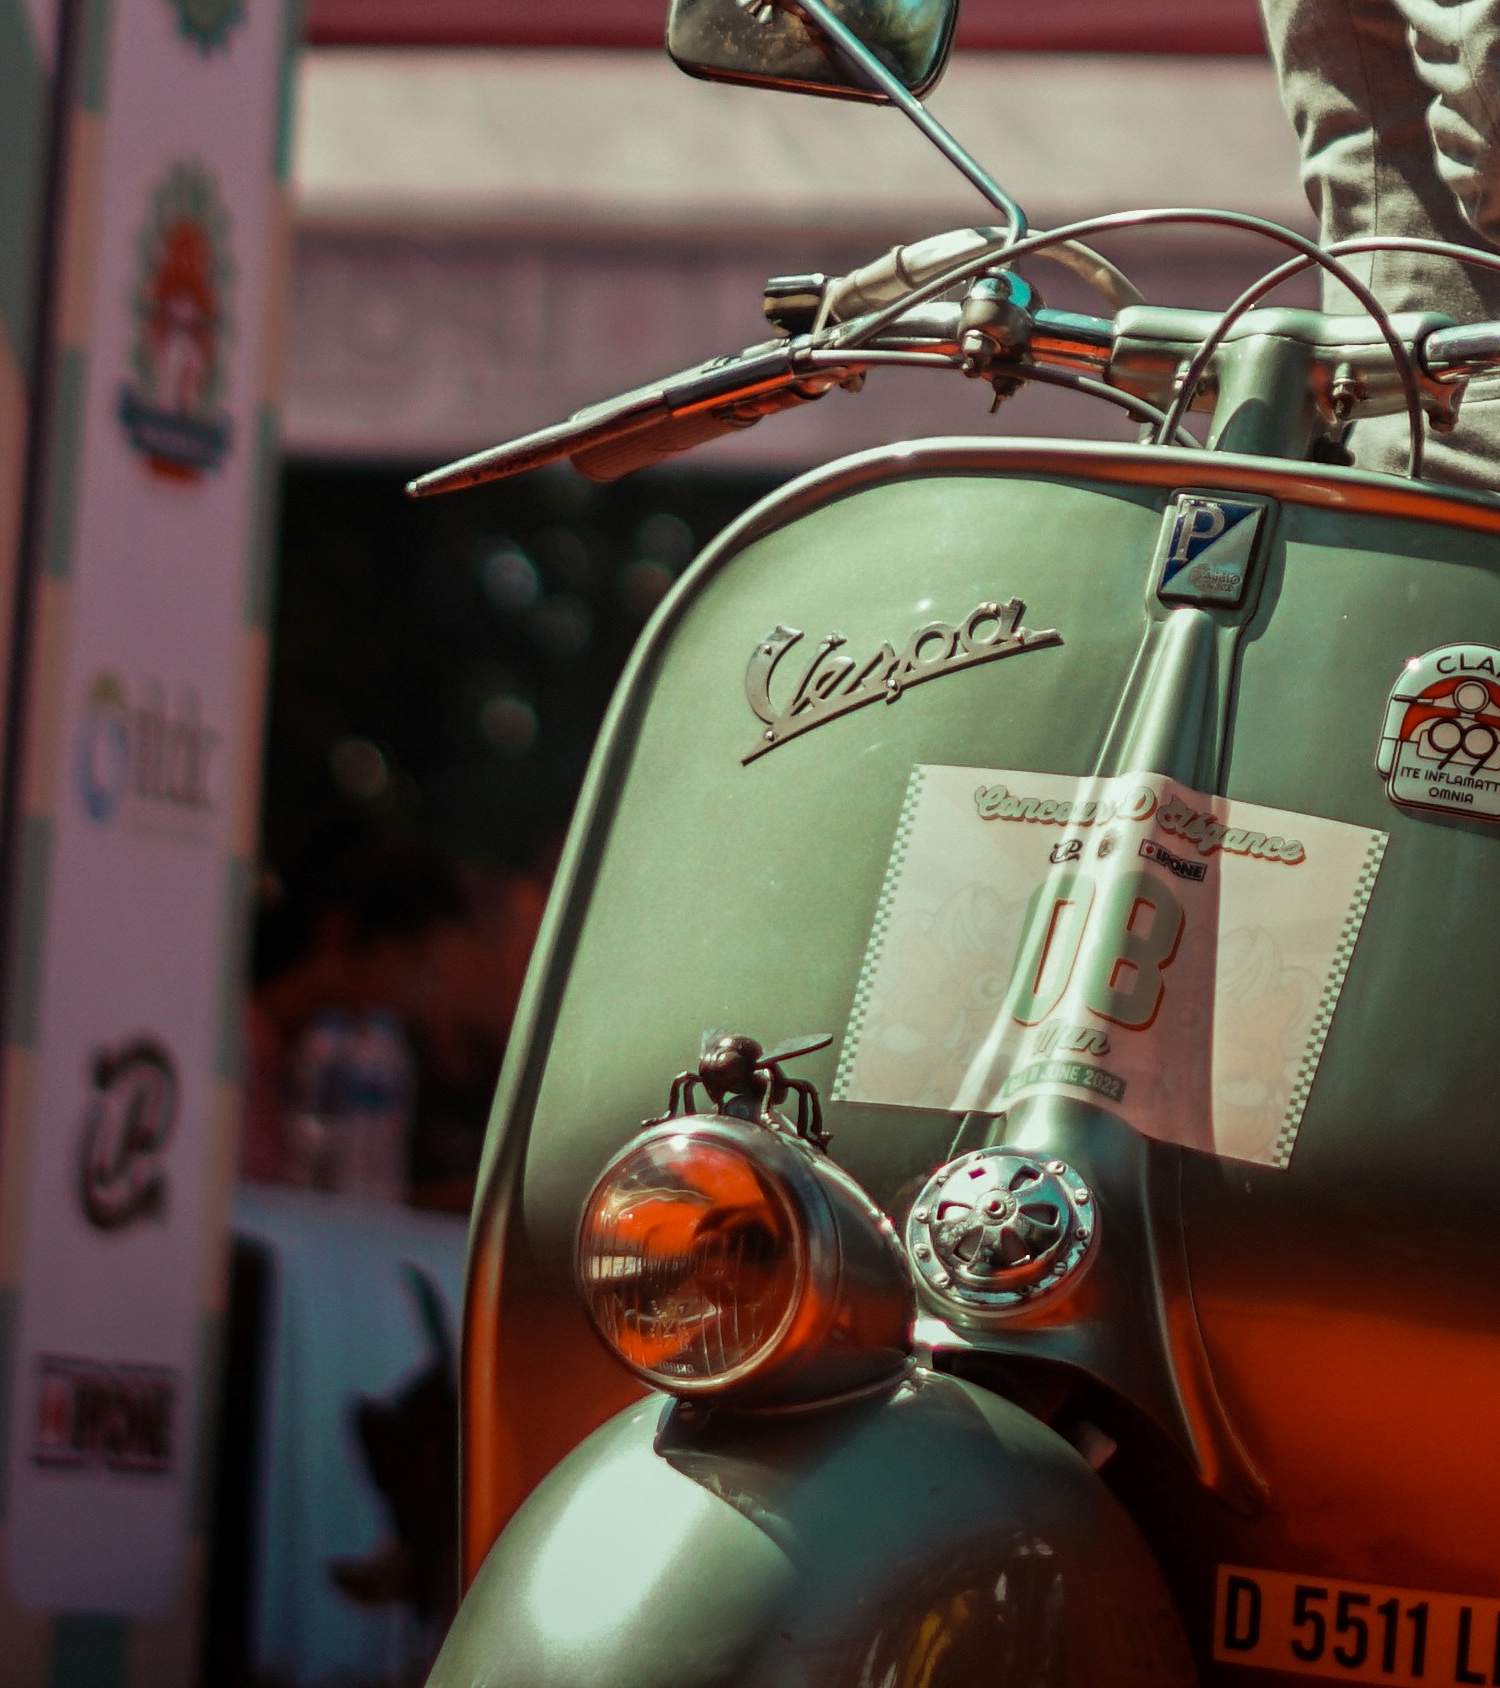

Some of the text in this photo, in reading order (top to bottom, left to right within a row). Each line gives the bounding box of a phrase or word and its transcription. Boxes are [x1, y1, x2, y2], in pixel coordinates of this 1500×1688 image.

[1171, 503, 1225, 561] P
[741, 597, 1064, 766] Vespa
[1400, 767, 1420, 779] ITE
[1428, 718, 1498, 775] 99
[1429, 786, 1474, 804] OMNIA
[1156, 794, 1307, 865] Elegance
[1156, 847, 1203, 878] IPONE
[1042, 1064, 1081, 1082] JUNE
[1082, 1069, 1121, 1097] 2022
[1224, 1575, 1262, 1651] D
[1290, 1585, 1430, 1677] 5511
